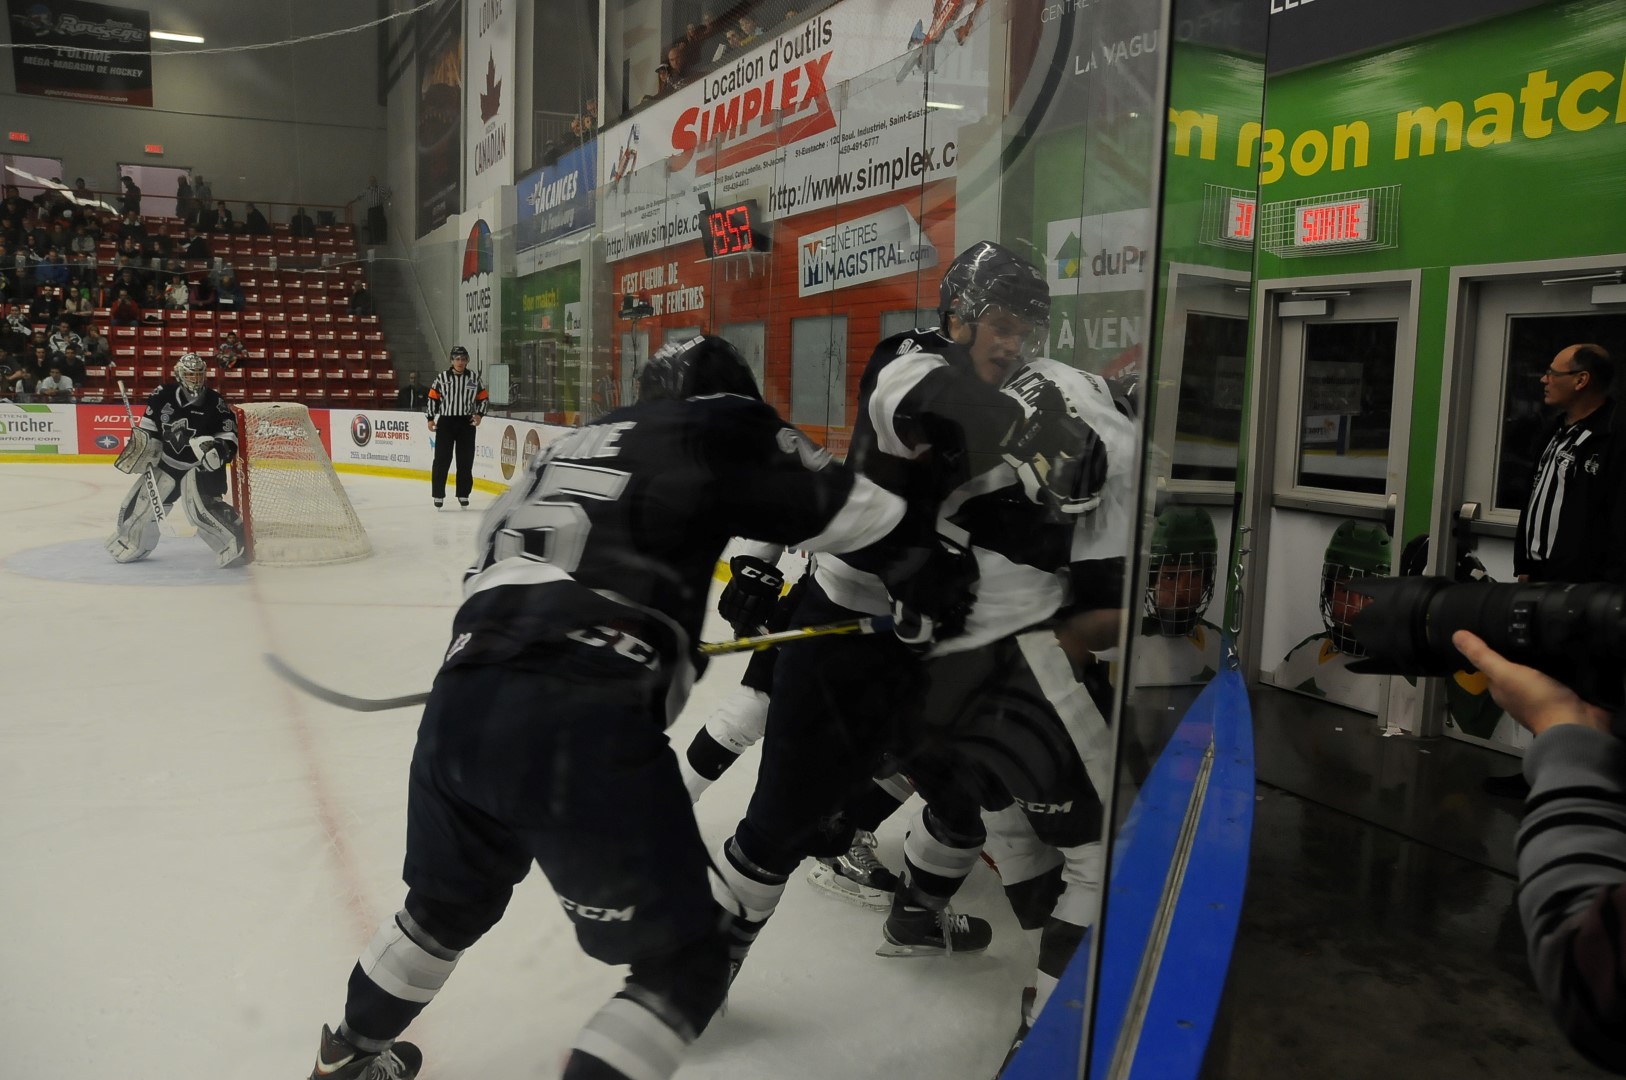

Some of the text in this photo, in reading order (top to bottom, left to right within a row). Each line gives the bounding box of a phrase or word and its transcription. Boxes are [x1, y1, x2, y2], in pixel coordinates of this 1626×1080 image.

[109, 67, 144, 78] HOCKEY
[703, 17, 833, 105] Location d'outils
[1075, 50, 1098, 75] LA
[671, 51, 834, 174] SIMPLEX
[474, 122, 506, 176] CANADIAN
[795, 142, 826, 158] St-Eustache
[841, 132, 856, 142] Boul.
[857, 120, 888, 137] Industriel,
[534, 170, 578, 215] VACANCES
[1302, 203, 1361, 242] SORTIE
[825, 222, 878, 255] FENÊTRES
[668, 262, 679, 285] DE
[466, 287, 491, 313] TOITURES
[666, 284, 705, 314] FENÊTRES
[468, 311, 488, 335] HOGUE
[8, 418, 54, 433] richer
[375, 420, 409, 432] LA CAGE
[375, 431, 409, 440] AUX SPORTS
[144, 470, 164, 522] Reebok
[741, 565, 784, 590] CC
